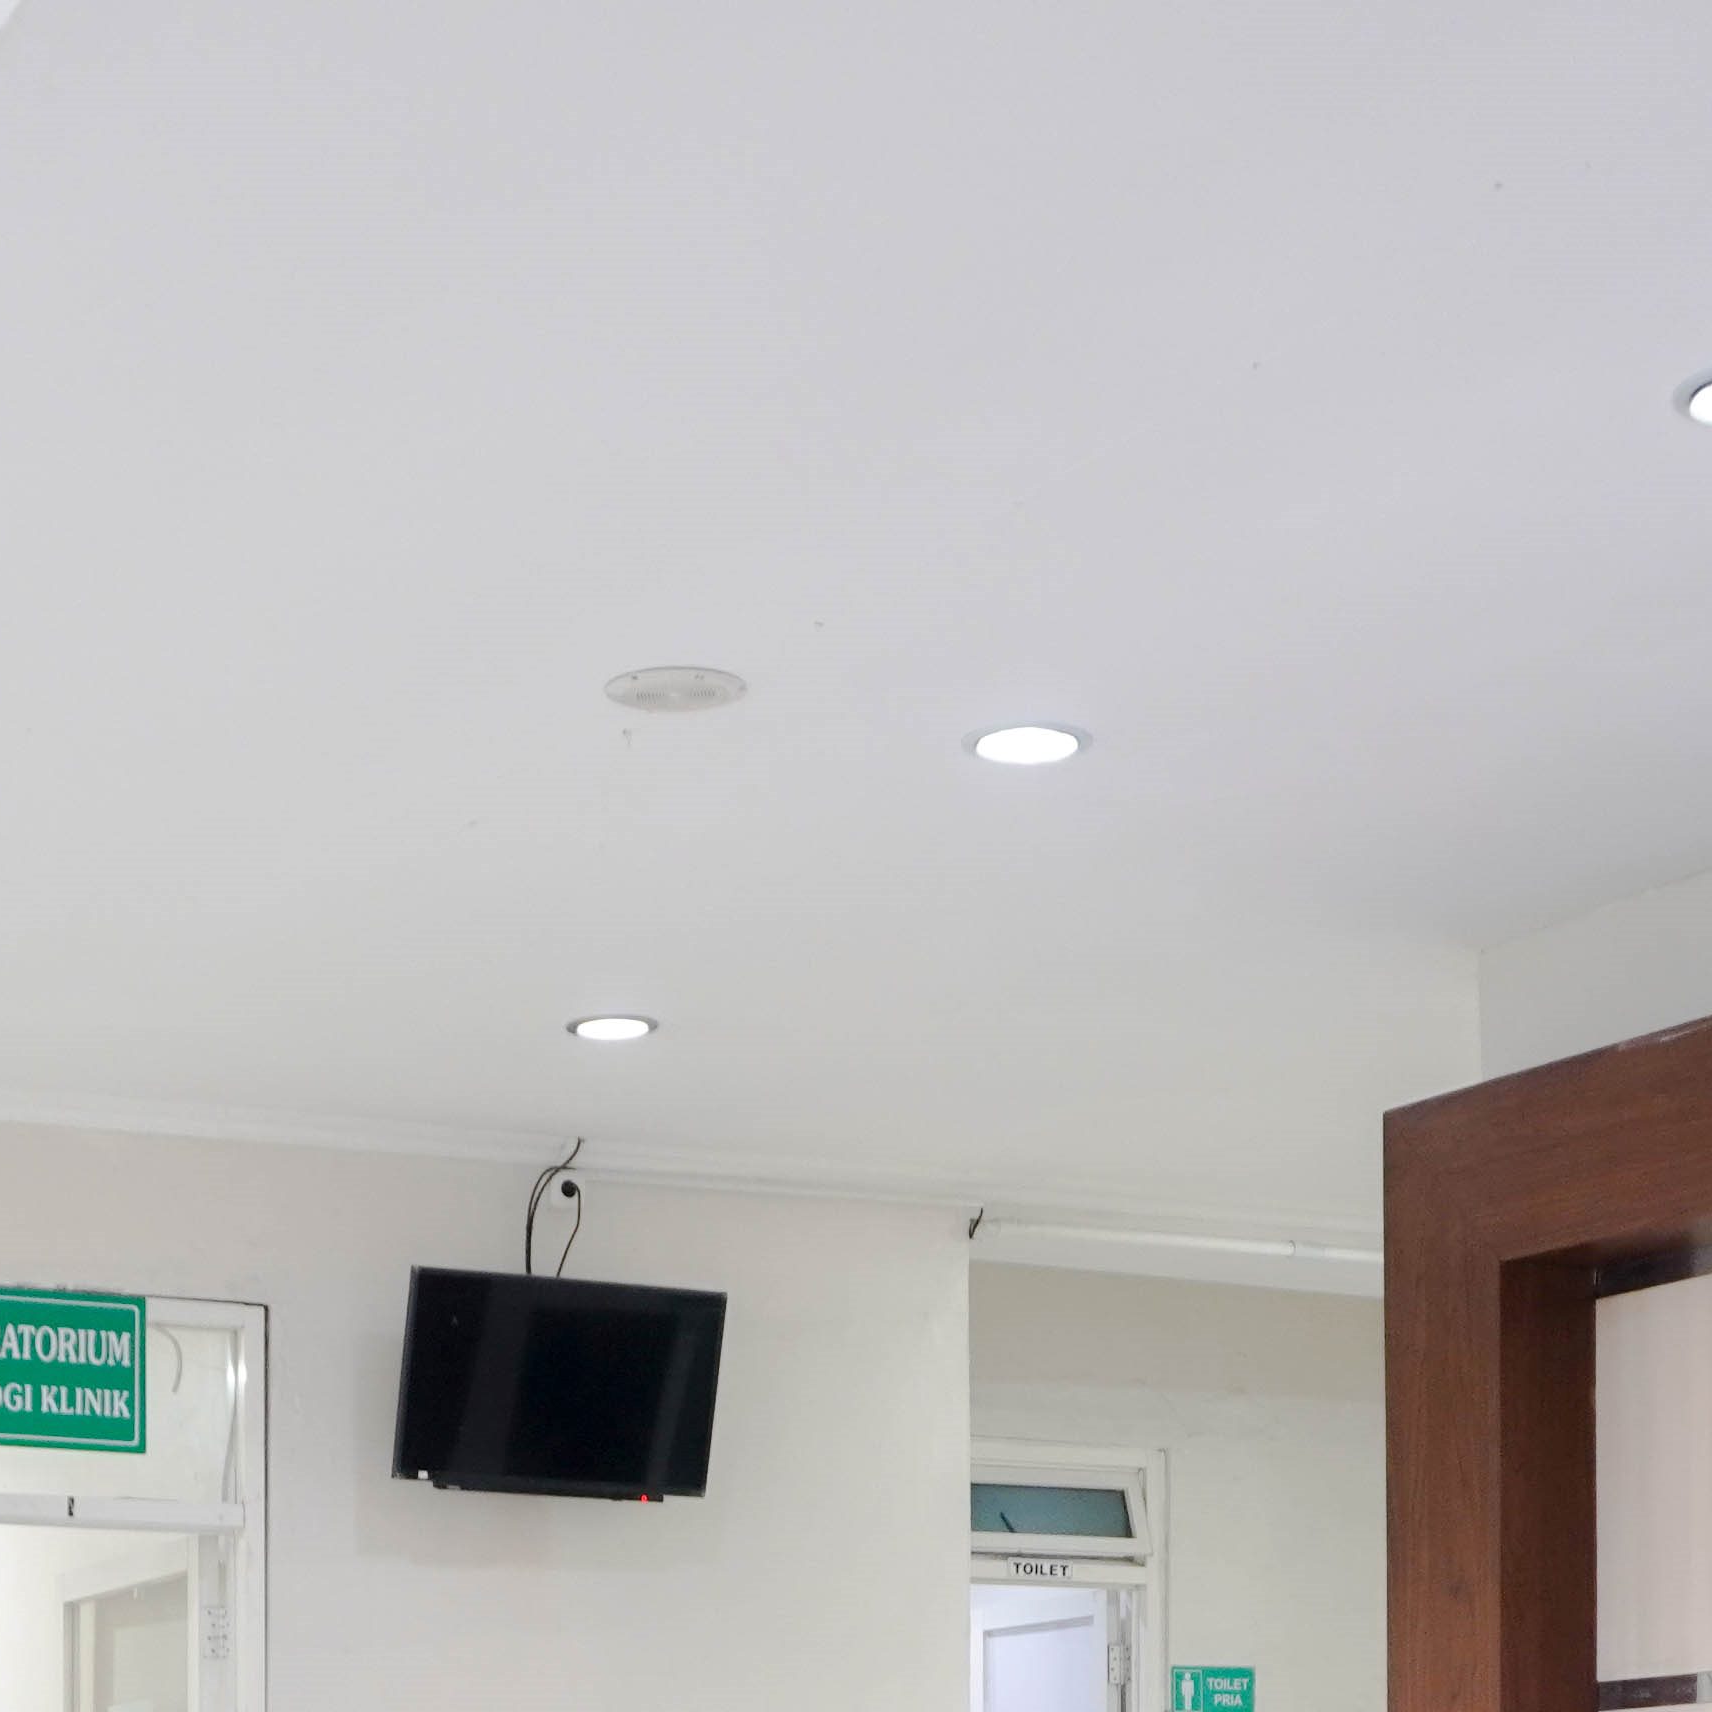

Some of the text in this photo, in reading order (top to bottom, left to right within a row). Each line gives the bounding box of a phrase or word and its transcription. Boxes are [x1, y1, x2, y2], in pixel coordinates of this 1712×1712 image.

[40, 1384, 131, 1419] KLINIK
[1013, 1562, 1069, 1577] TOILET
[1206, 1677, 1249, 1691] TOILET
[1214, 1694, 1243, 1707] PRIA
